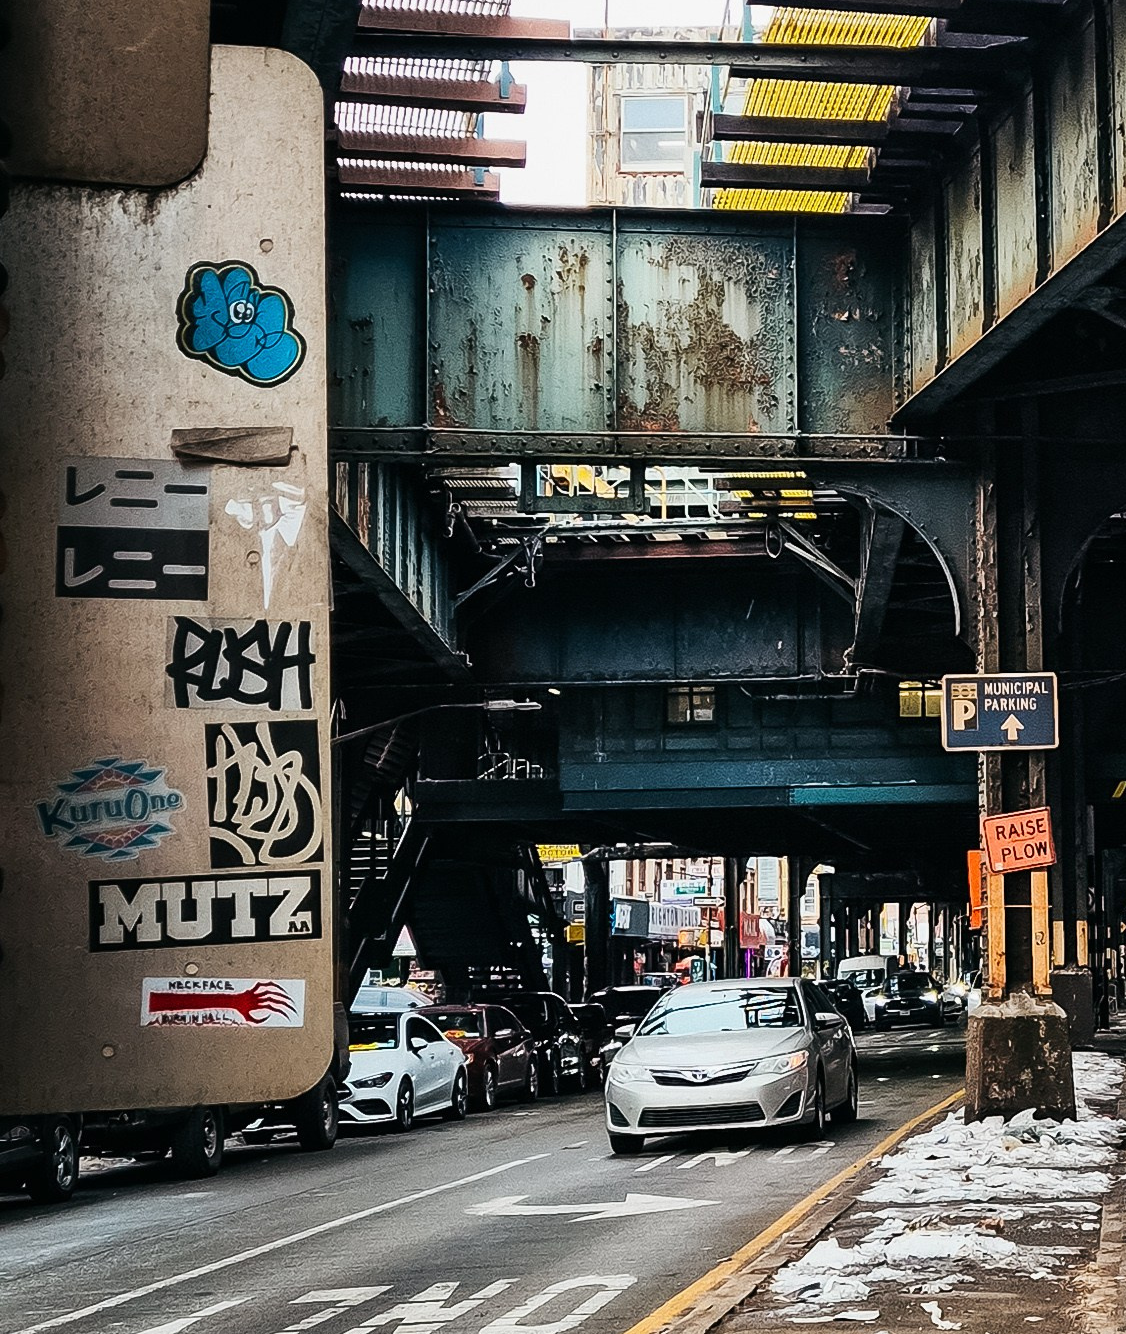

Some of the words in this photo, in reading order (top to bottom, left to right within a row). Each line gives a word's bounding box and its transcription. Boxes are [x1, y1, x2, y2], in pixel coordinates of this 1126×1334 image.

[984, 681, 1049, 696] MUNICIPAL
[953, 699, 976, 731] P
[984, 697, 1037, 712] PARKING
[37, 788, 181, 836] KuruOne
[995, 817, 1047, 841] RAISE
[1001, 841, 1048, 863] PLOW
[99, 876, 313, 944] MUTZ
[288, 920, 310, 933] AA
